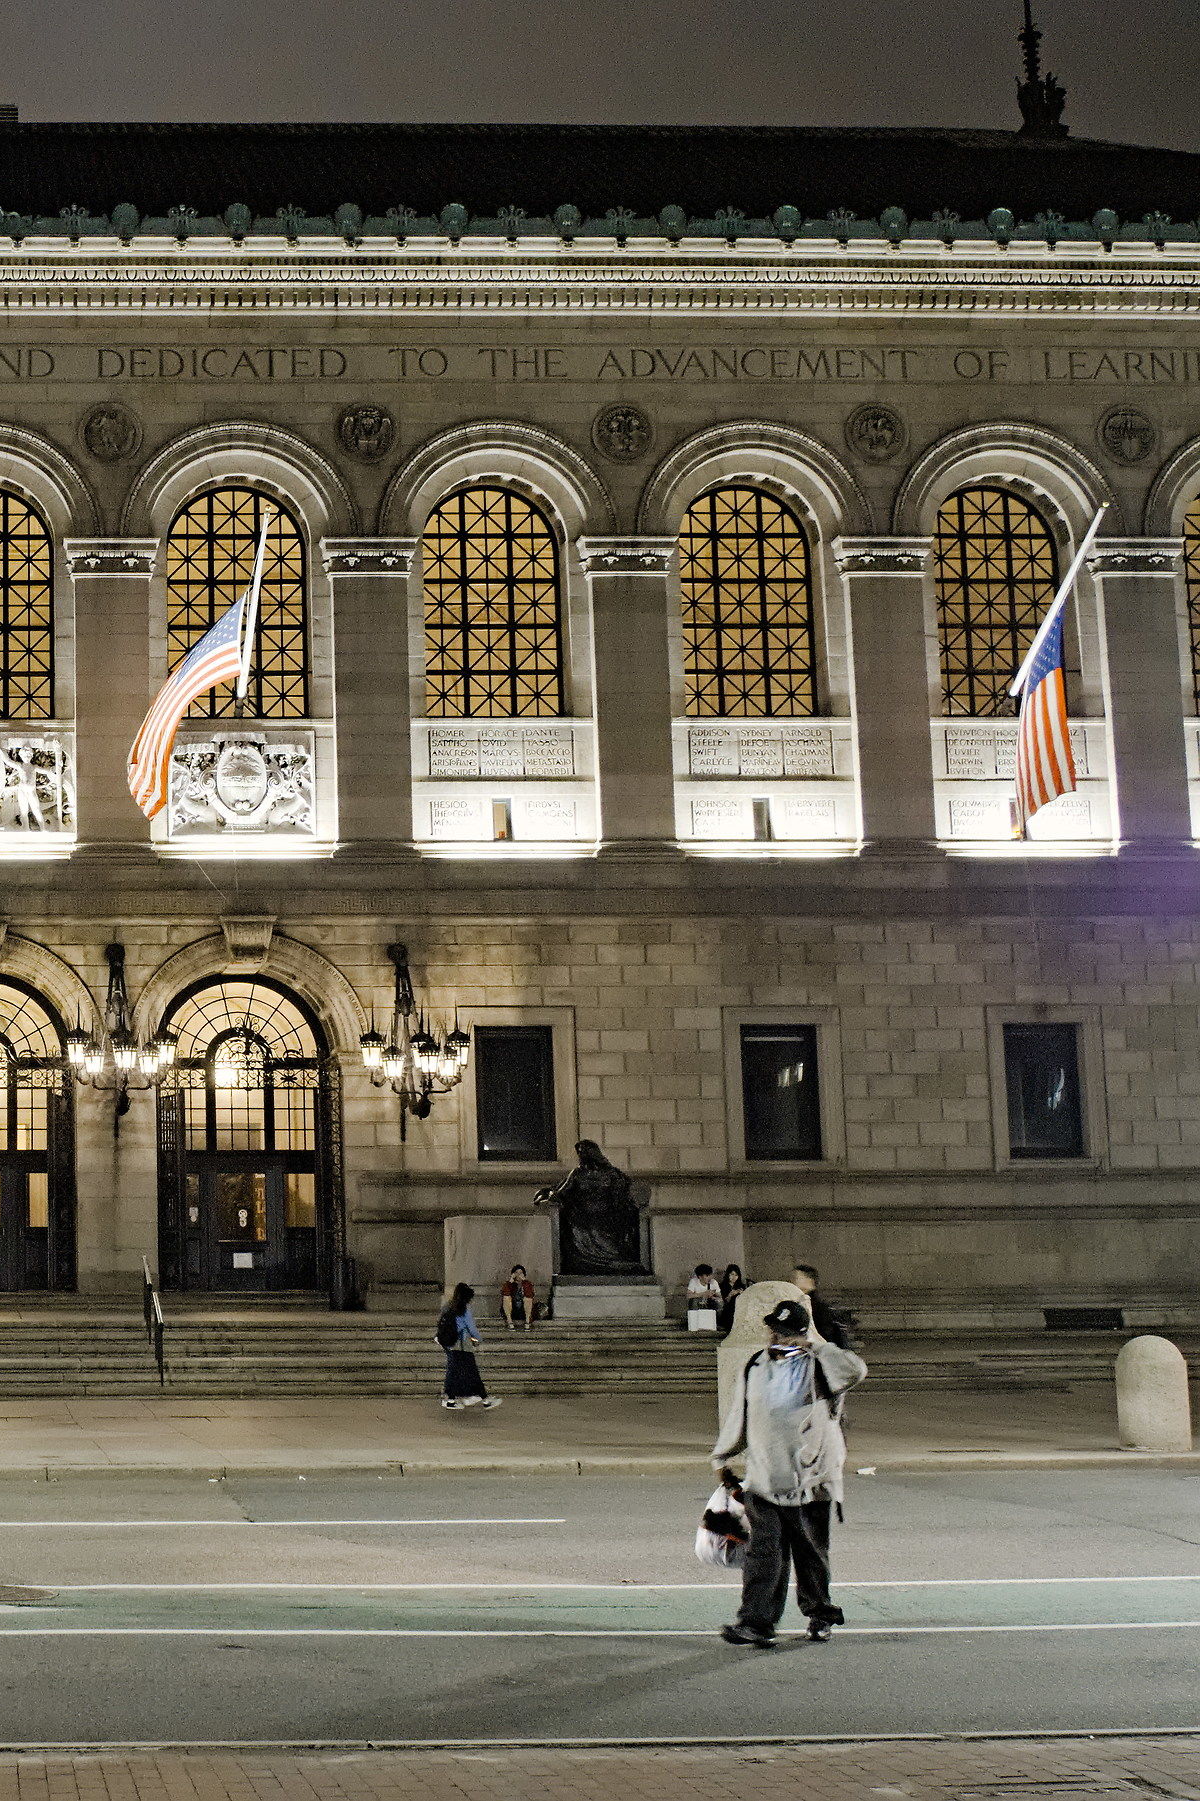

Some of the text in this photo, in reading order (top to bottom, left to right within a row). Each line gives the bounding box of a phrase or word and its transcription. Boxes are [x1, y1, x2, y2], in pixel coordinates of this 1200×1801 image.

[97, 348, 348, 378] DEDICATED
[388, 348, 449, 377] TO
[478, 348, 568, 378] THE
[597, 348, 918, 379] ADVANCEMENT
[953, 350, 1010, 379] OF
[432, 729, 465, 738] HOMER
[481, 729, 518, 738] HORACE
[525, 729, 560, 737] DANTE
[691, 728, 730, 737] ADDISON
[741, 729, 774, 737] SYDNEY
[785, 728, 822, 737] ARNOLD
[431, 739, 468, 747] SAPPHO
[482, 739, 507, 747] OVID
[691, 738, 723, 746] STEELE
[741, 738, 770, 747] DEFOE
[785, 738, 825, 746] ASCHAM
[432, 749, 478, 757] ANACREON
[526, 748, 571, 756] BOCCACCIO
[692, 748, 717, 756] SWIFT
[785, 748, 829, 756] CHAPMAN
[692, 758, 733, 766] CARLYLE
[950, 757, 983, 766] DARWIN
[432, 768, 478, 776] SIMONIDES
[527, 767, 570, 776] LEOPARDI
[692, 767, 720, 776] LAMB
[742, 767, 777, 776] WALTON
[433, 800, 468, 809] HESIOD
[694, 800, 738, 808] JOHNSON
